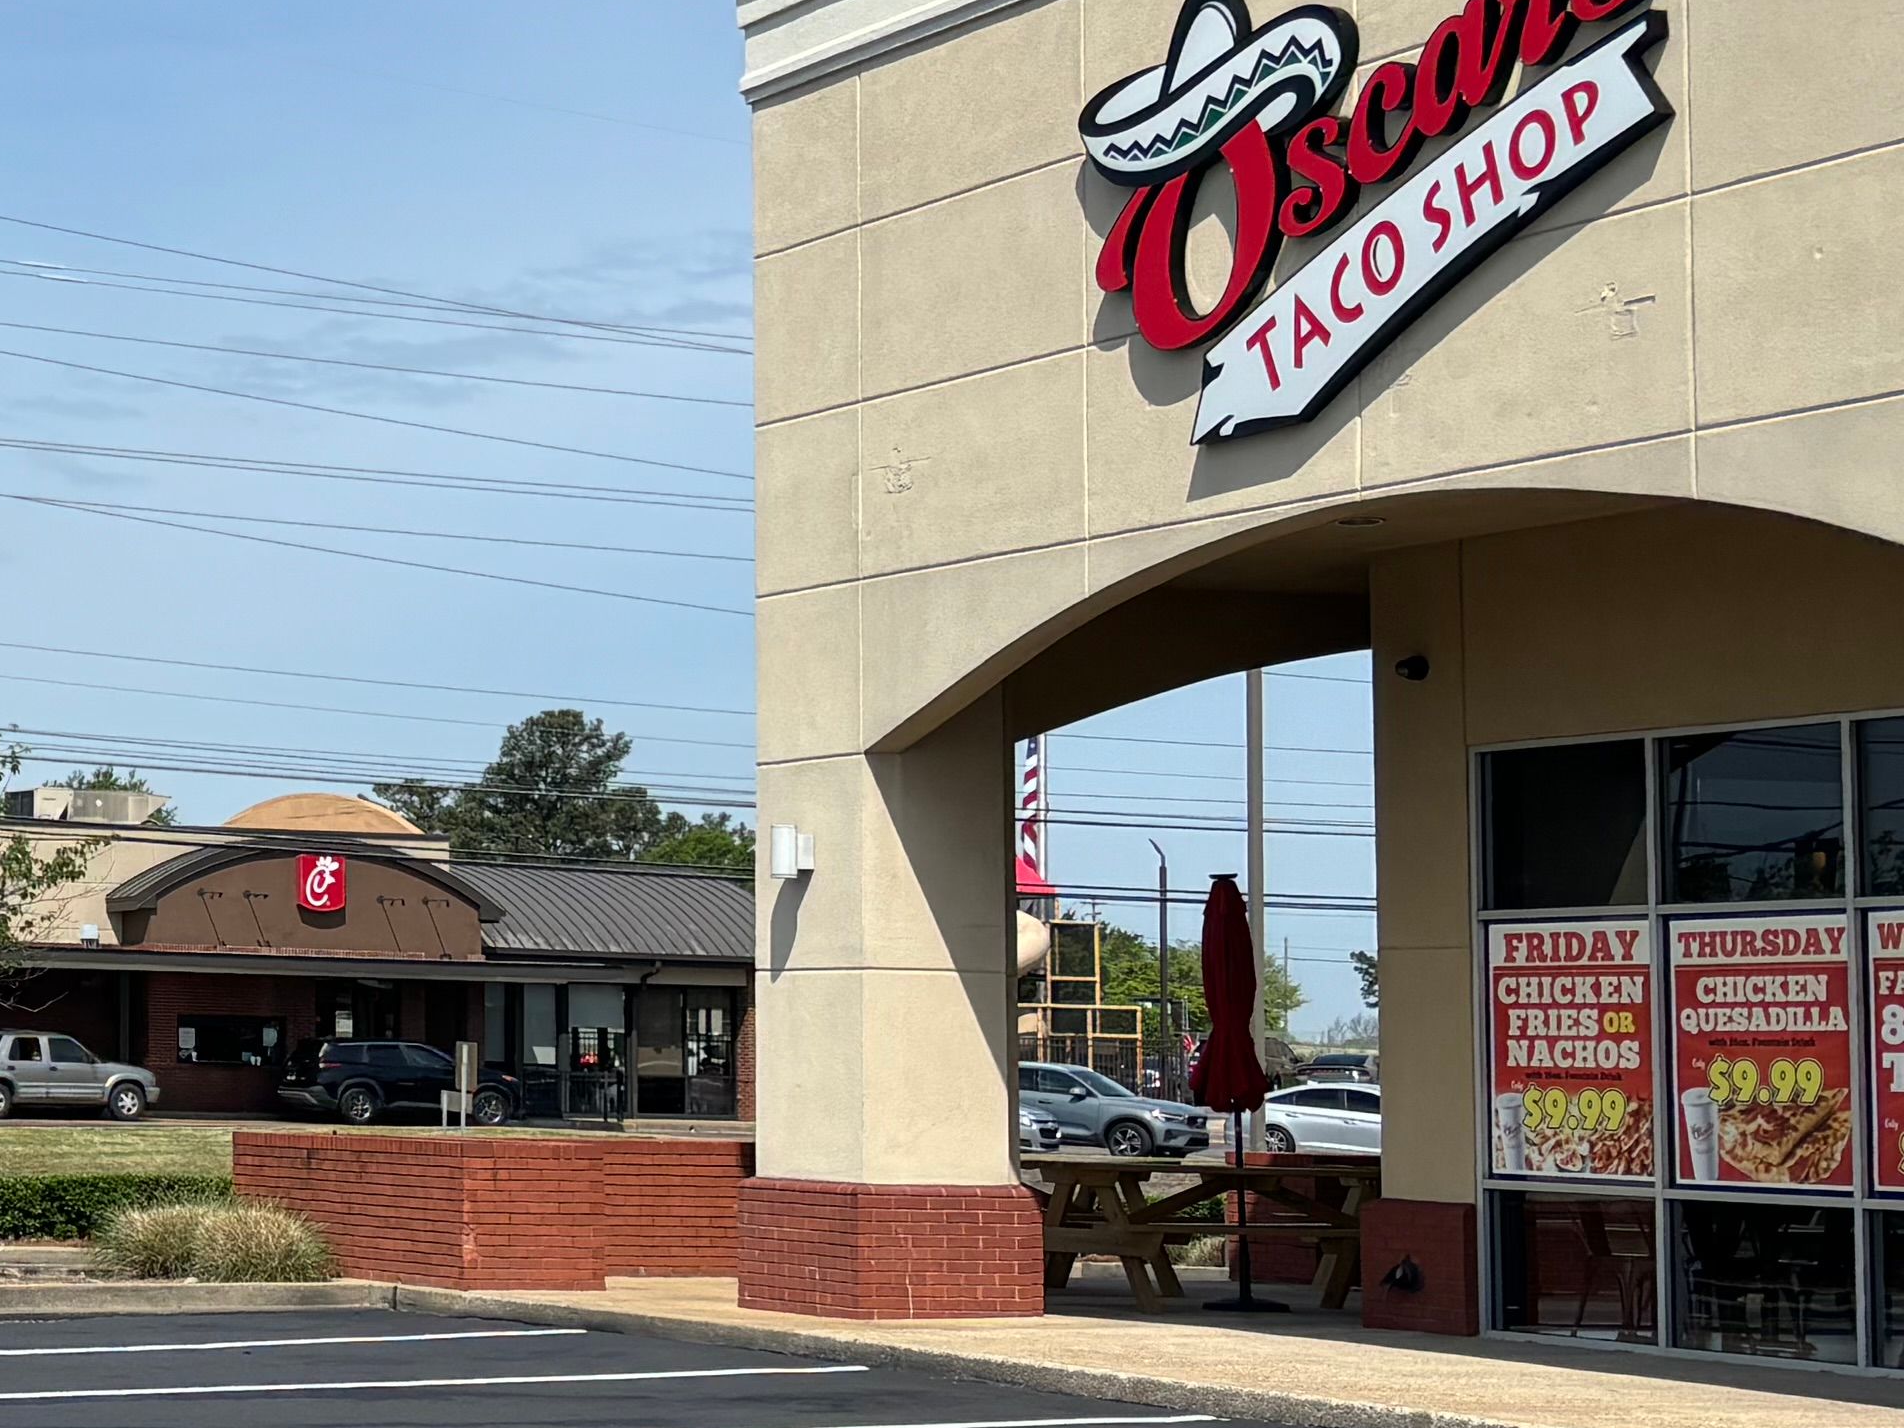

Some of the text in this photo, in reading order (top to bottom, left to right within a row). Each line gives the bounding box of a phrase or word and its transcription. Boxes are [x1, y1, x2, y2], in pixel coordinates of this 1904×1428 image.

[1245, 81, 1599, 391] TACO SHOP
[1503, 930, 1640, 963] FRIDAY
[1677, 926, 1846, 959] THURSDAY
[1497, 976, 1644, 1004] CHICKEN
[1695, 974, 1828, 1004] CHICKEN
[1508, 1008, 1636, 1037] FRIES OR
[1679, 1006, 1849, 1035] QUESADILLA
[1507, 1039, 1641, 1069] NACHOS
[1707, 1052, 1825, 1106] $9.99
[1522, 1082, 1627, 1133] $9.99
